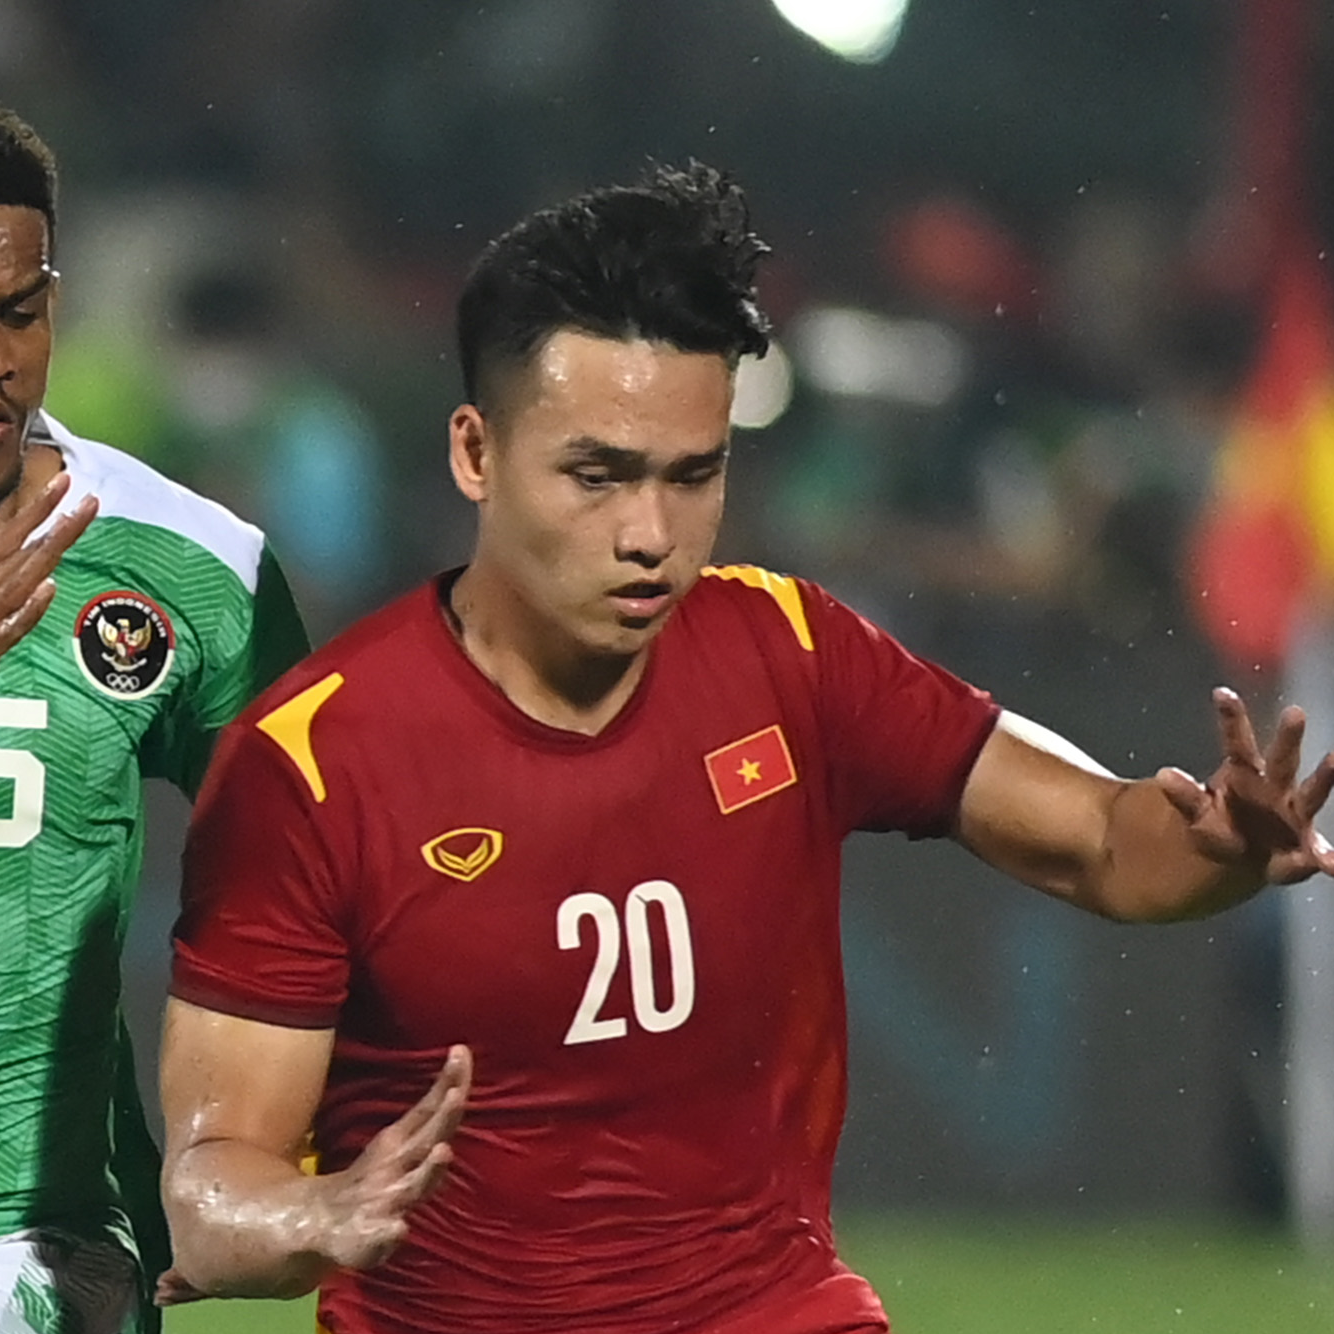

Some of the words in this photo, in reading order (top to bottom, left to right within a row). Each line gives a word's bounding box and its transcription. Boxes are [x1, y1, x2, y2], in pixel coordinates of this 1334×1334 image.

[83, 606, 101, 627] TIM
[101, 598, 166, 638] INDONESIA
[556, 879, 695, 1045] 20
